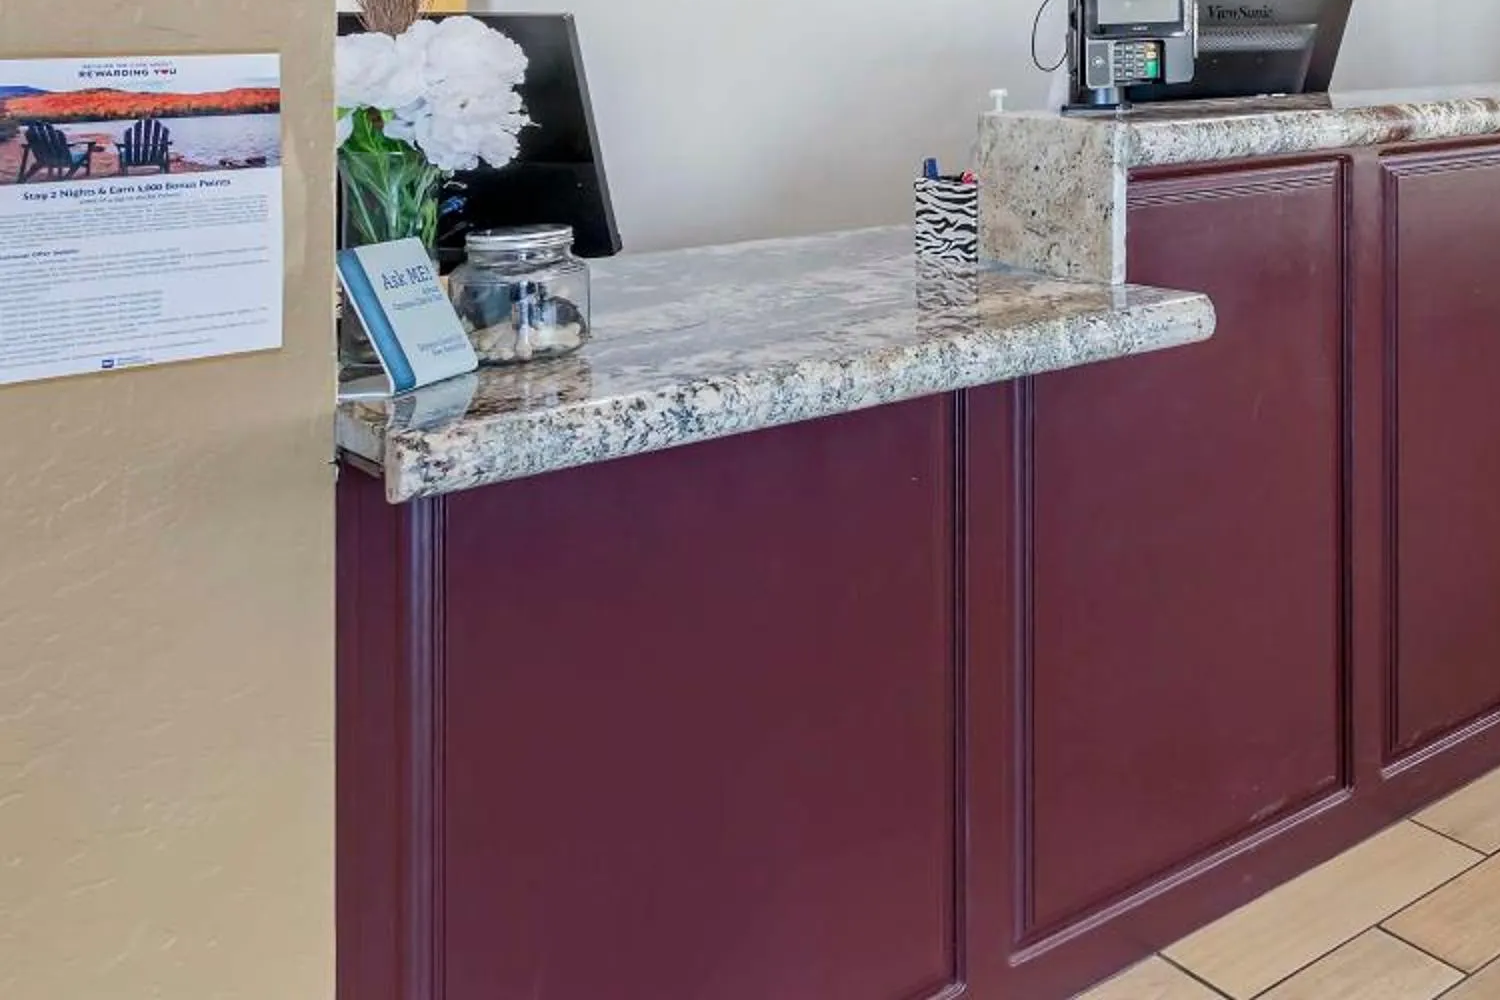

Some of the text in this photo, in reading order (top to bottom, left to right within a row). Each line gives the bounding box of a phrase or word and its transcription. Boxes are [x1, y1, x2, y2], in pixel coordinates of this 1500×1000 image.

[1207, 4, 1273, 20] ViewSonic
[78, 69, 149, 78] REWARDING
[59, 187, 96, 199] Nights
[109, 185, 135, 195] Earn
[199, 178, 231, 188] Points
[381, 270, 409, 290] Ask
